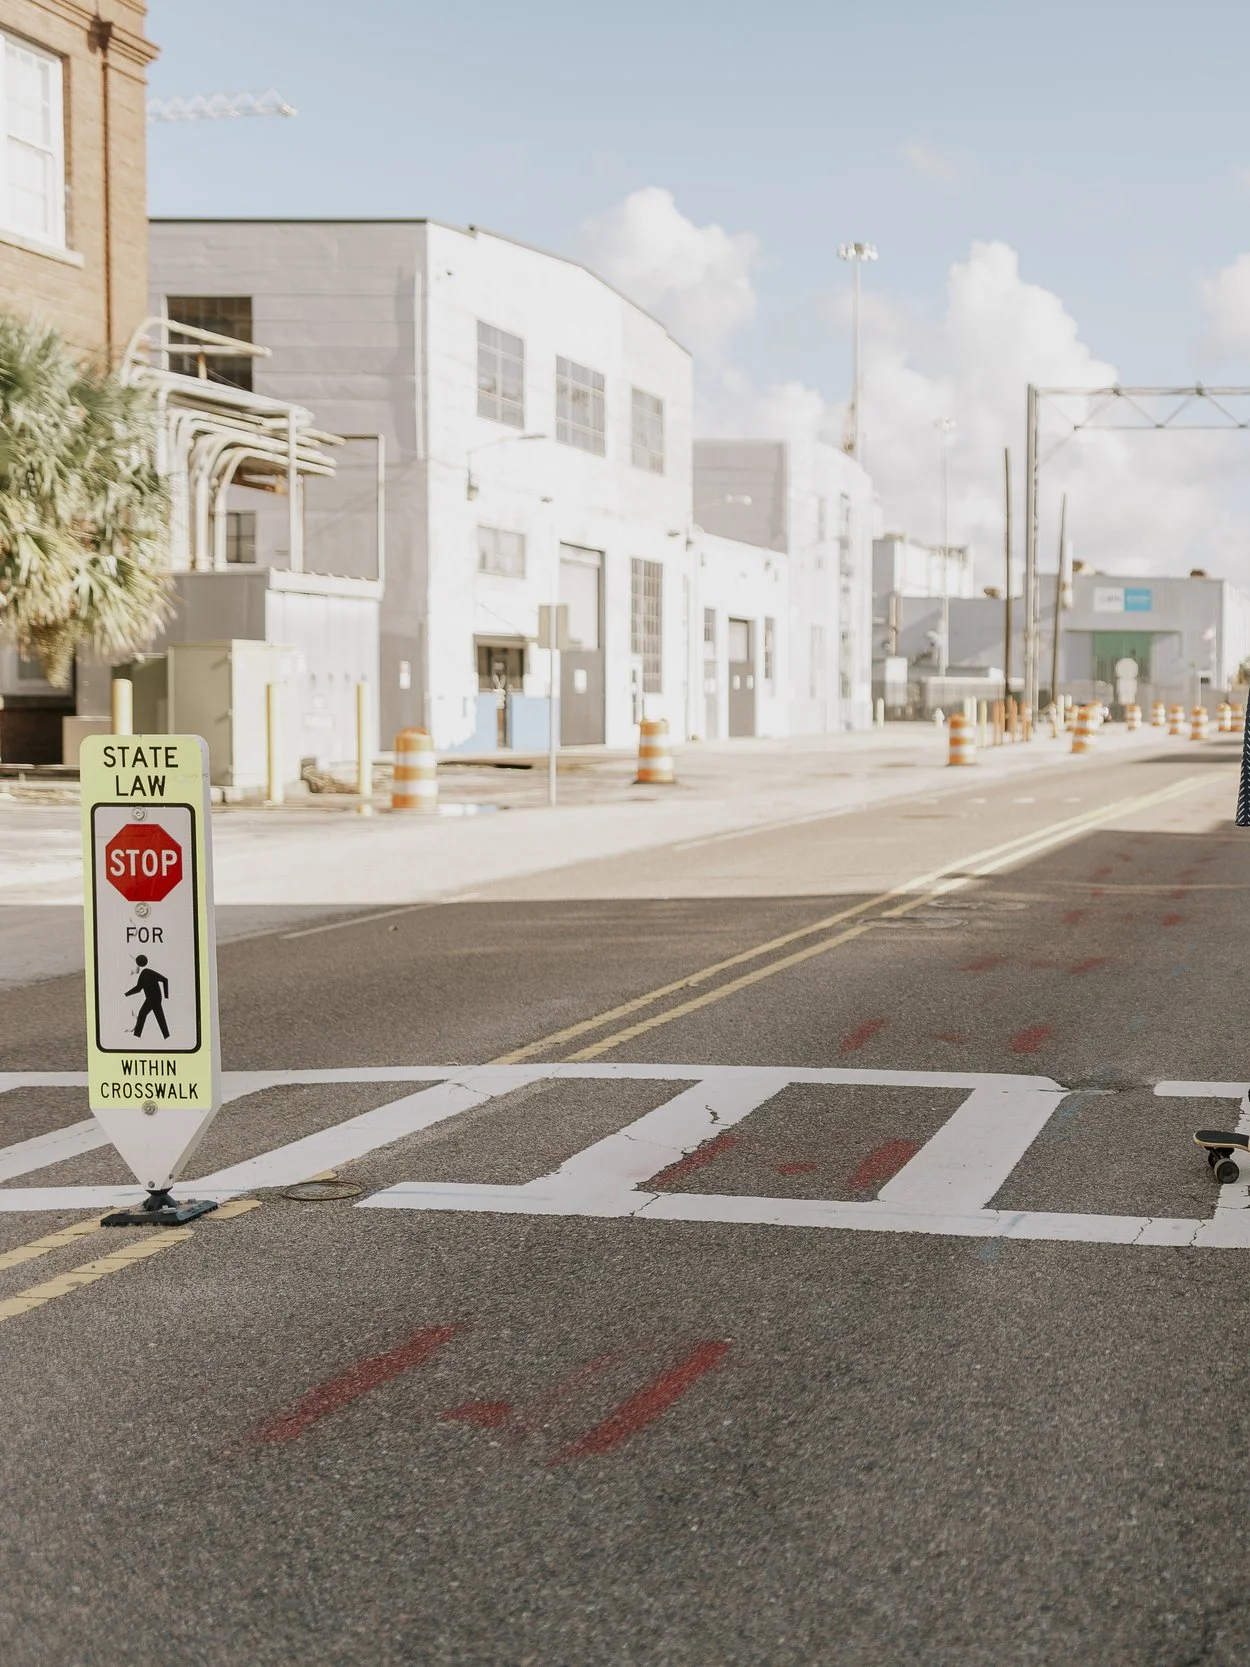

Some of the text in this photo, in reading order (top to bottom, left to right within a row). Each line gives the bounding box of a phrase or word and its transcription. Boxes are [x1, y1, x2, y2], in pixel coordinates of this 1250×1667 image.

[103, 746, 178, 768] STATE
[115, 775, 166, 796] LAW
[110, 849, 178, 877] STOP
[126, 927, 163, 944] FOR
[121, 1060, 177, 1076] WITHIN
[100, 1082, 199, 1099] CROSSWALK
